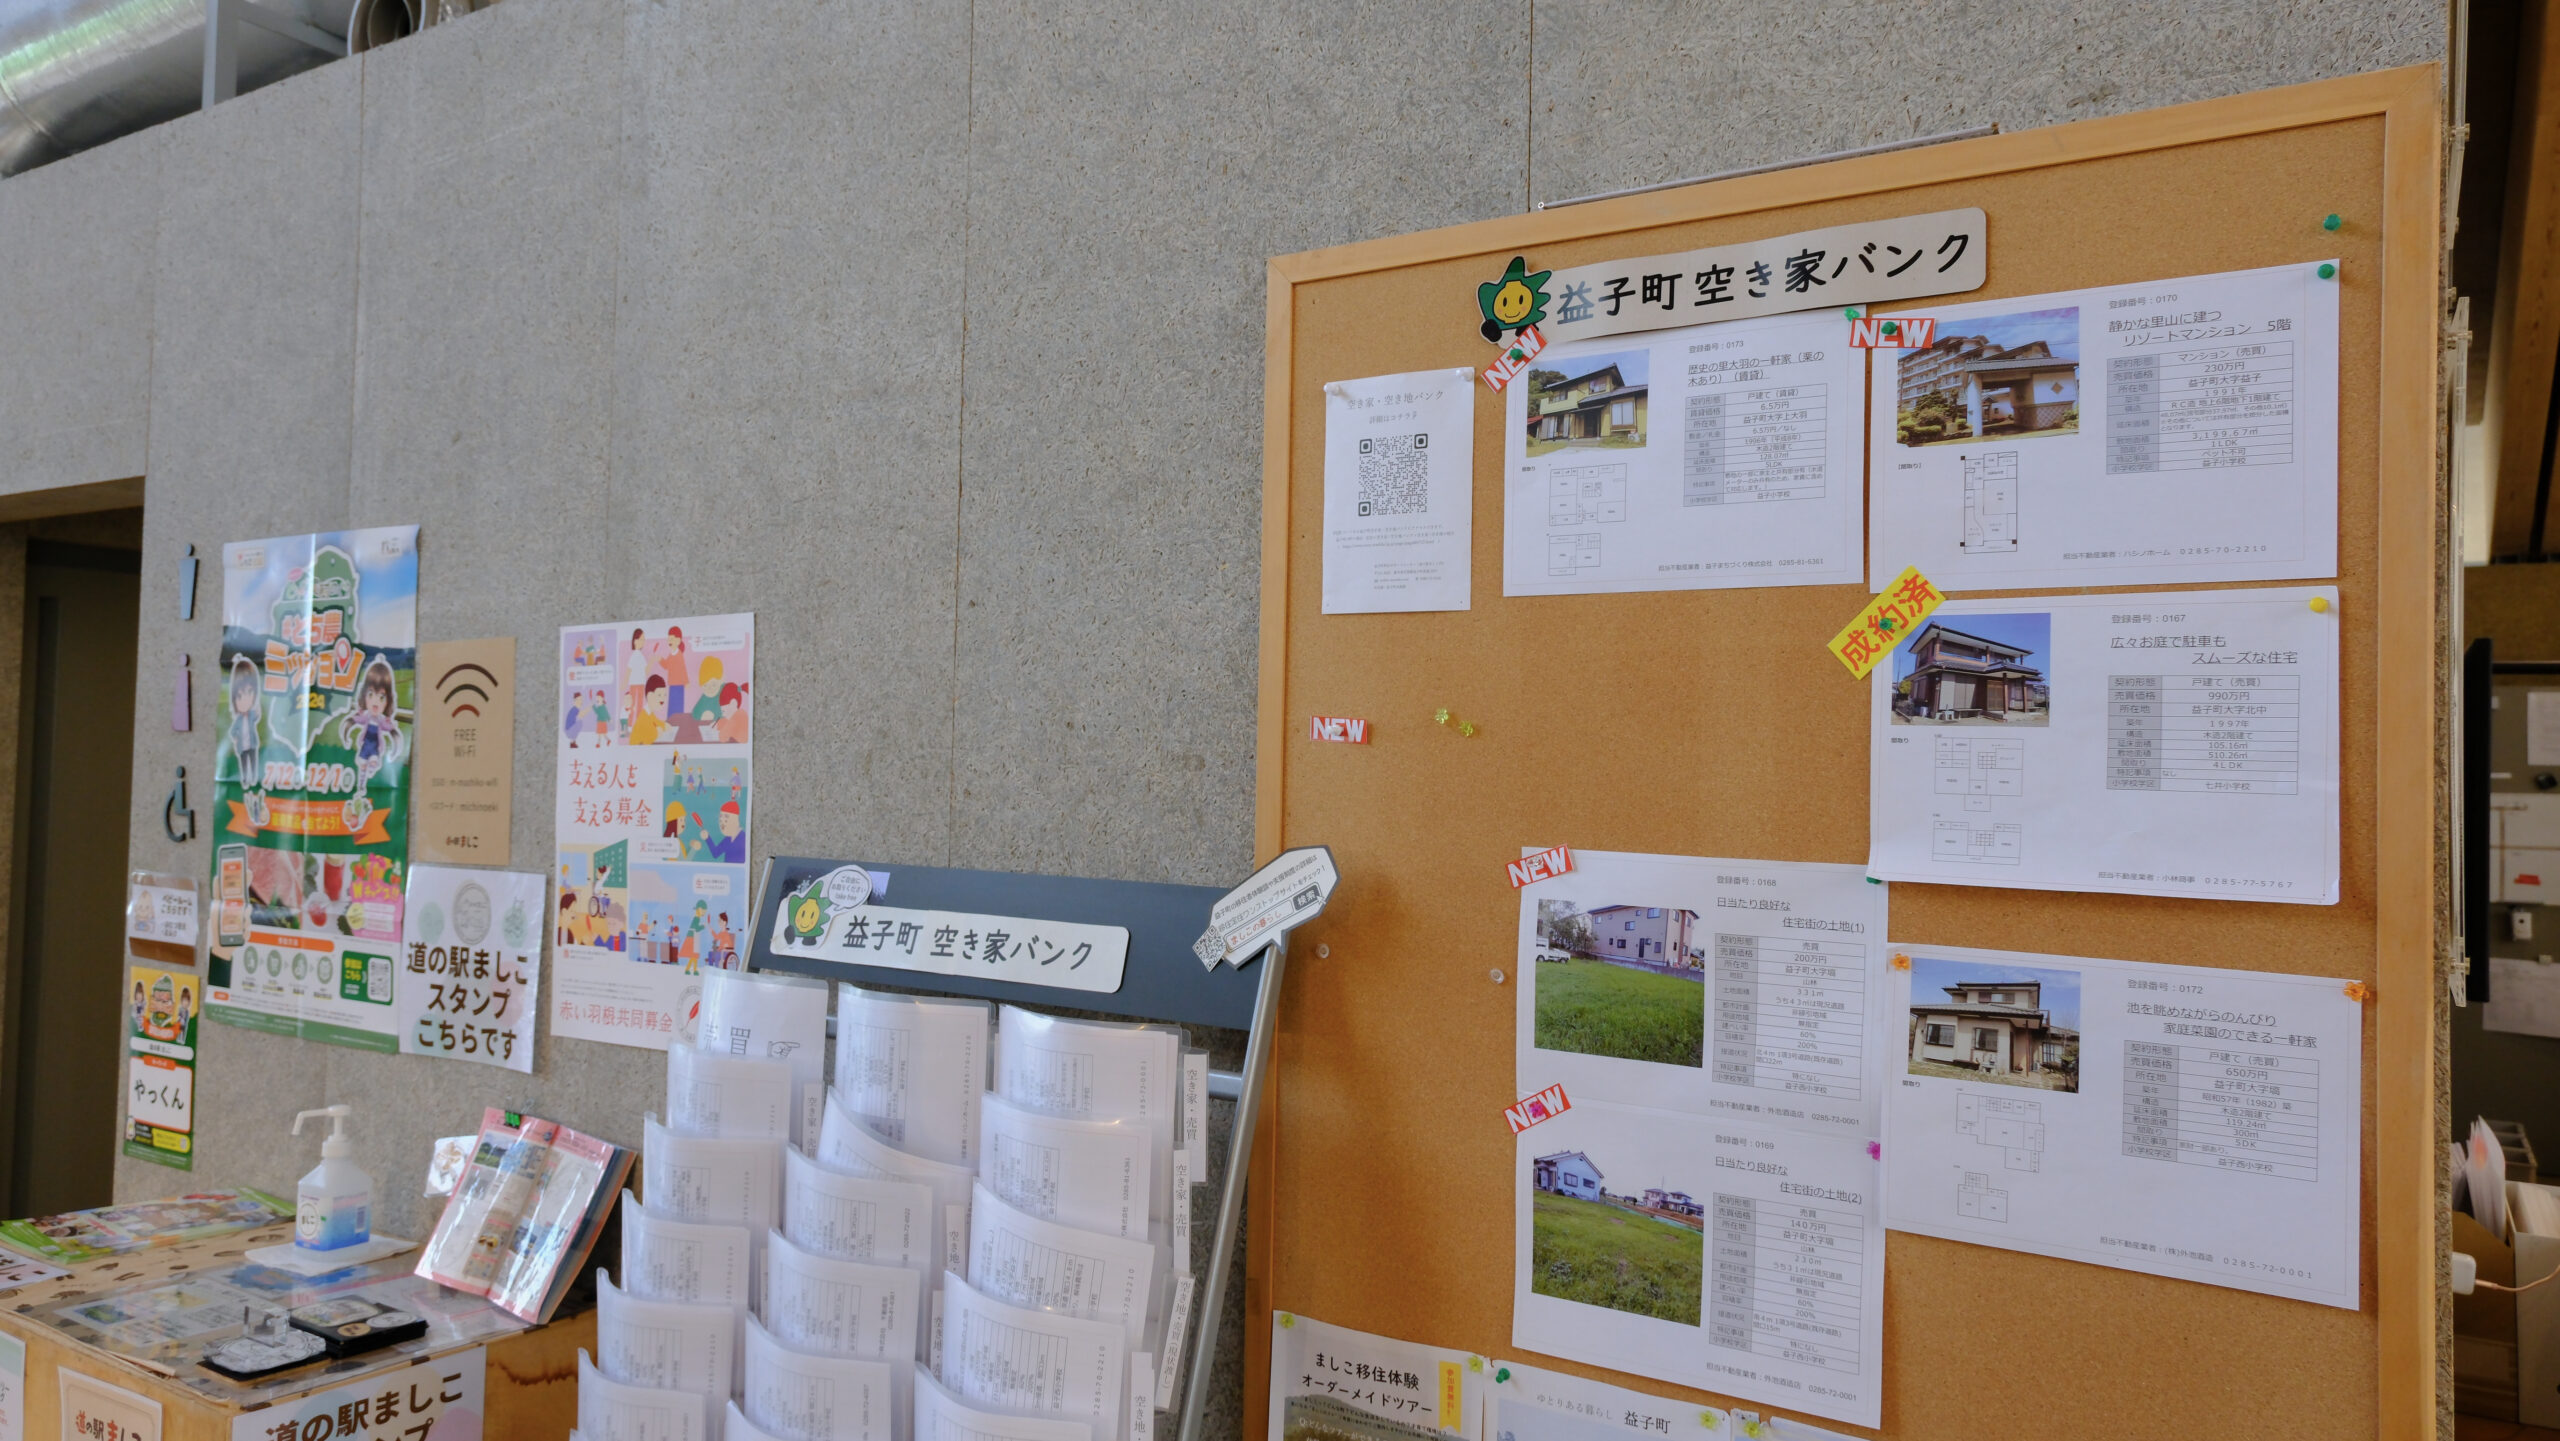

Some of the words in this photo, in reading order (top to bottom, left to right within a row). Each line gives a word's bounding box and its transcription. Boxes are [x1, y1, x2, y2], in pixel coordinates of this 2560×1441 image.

[2109, 293, 2178, 309] 登録番号：0170
[2109, 310, 2222, 333] 静かな里山に建つ
[2267, 318, 2292, 333] 5階
[1852, 319, 1934, 348] NEW
[1689, 341, 1744, 354] 登録番号：0173
[2178, 345, 2267, 362] マンション（売買）
[1486, 329, 1544, 390] NEW
[2204, 361, 2245, 373] 230万円
[2188, 373, 2262, 388] 益子町大字益子
[2118, 384, 2148, 394] 所在地
[1347, 389, 1444, 410] 空き家・空き地バンク
[1760, 401, 1790, 411] 6.5万円
[1693, 420, 1717, 429] 所在地
[1743, 411, 1808, 424] 益子町大字上大羽
[2202, 447, 2246, 458] ペット不可
[2202, 457, 2247, 468] 益子小学校
[2180, 545, 2267, 555] 0285-70-2210
[1839, 573, 1937, 671] 成約済
[2111, 614, 2186, 624] 登録番号：0167
[2110, 636, 2227, 649] 広々お庭で駐車も
[2191, 651, 2298, 665] スムーズな住宅
[2114, 678, 2156, 688] 契約形態
[2191, 677, 2262, 688] 戸建て（売買）
[2114, 691, 2156, 701] 売買価格
[2208, 691, 2250, 701] 990万円
[2119, 705, 2151, 714] 所在地
[2191, 705, 2267, 715] 益子町大字北中
[1312, 716, 1364, 742] NEW
[2126, 718, 2143, 727] 築年
[454, 728, 476, 741] FREE
[569, 759, 638, 789] 支える人を
[2162, 769, 2177, 777] なし
[2111, 778, 2155, 788] 小学校学区
[2205, 782, 2251, 791] 七井小学校
[573, 796, 652, 828] 支える募金
[1507, 847, 1569, 885] NEW
[1716, 875, 1777, 888] 登録番号：0168
[2204, 876, 2293, 889] 0285-77-5767
[1297, 890, 1317, 907] 検索
[1716, 897, 1791, 912] 日当たり良好な
[1231, 911, 1282, 946] ましこの暮らし
[1782, 917, 1865, 934] 住宅街の土地(1)
[1802, 942, 1819, 951] 売買
[407, 942, 529, 985] 道の駅ましこ
[1723, 960, 1749, 970] 所在地
[1794, 954, 1827, 965] 200万円
[2127, 978, 2204, 995] 登録番号：0172
[428, 983, 512, 1020] スタンプ
[559, 1000, 673, 1033] 赤い羽根共同募金
[2126, 1001, 2277, 1027] 池を眺めながらのんびり
[419, 1019, 517, 1060] こちらです
[2163, 1022, 2318, 1049] 家庭菜園のできる一軒家
[2130, 1043, 2173, 1056] 契約形態
[2130, 1056, 2173, 1070] 売買価格
[2209, 1051, 2280, 1068] 戸建て（売買）
[1792, 1072, 1820, 1082] 特になし
[2135, 1071, 2167, 1083] 所在地
[2225, 1067, 2268, 1081] 650万円
[134, 1079, 184, 1110] やっくん
[1186, 1069, 1199, 1141] 空き家・売買
[1504, 1086, 1565, 1133] NEW
[1811, 1113, 1860, 1126] 0285-72-0001
[1715, 1134, 1774, 1150] 登録番号：0169
[1715, 1156, 1788, 1176] 日当たり良好な
[2218, 1158, 2273, 1173] 益子西小学校
[1175, 1162, 1188, 1238] 空き家・売買
[1779, 1181, 1862, 1205] 住宅街の土地(2)
[1800, 1208, 1817, 1219] 売買
[2223, 1257, 2313, 1279] 0285-72-0001
[1316, 1352, 1420, 1391] ましこ移住体験
[1302, 1373, 1433, 1414] オーダーメイドツアー
[1808, 1384, 1857, 1401] 0285-72-0001
[266, 1371, 463, 1441] 道の駅ましこ
[1536, 1394, 1614, 1420] ゆとりある暮らし
[1623, 1409, 1672, 1434] 益子町
